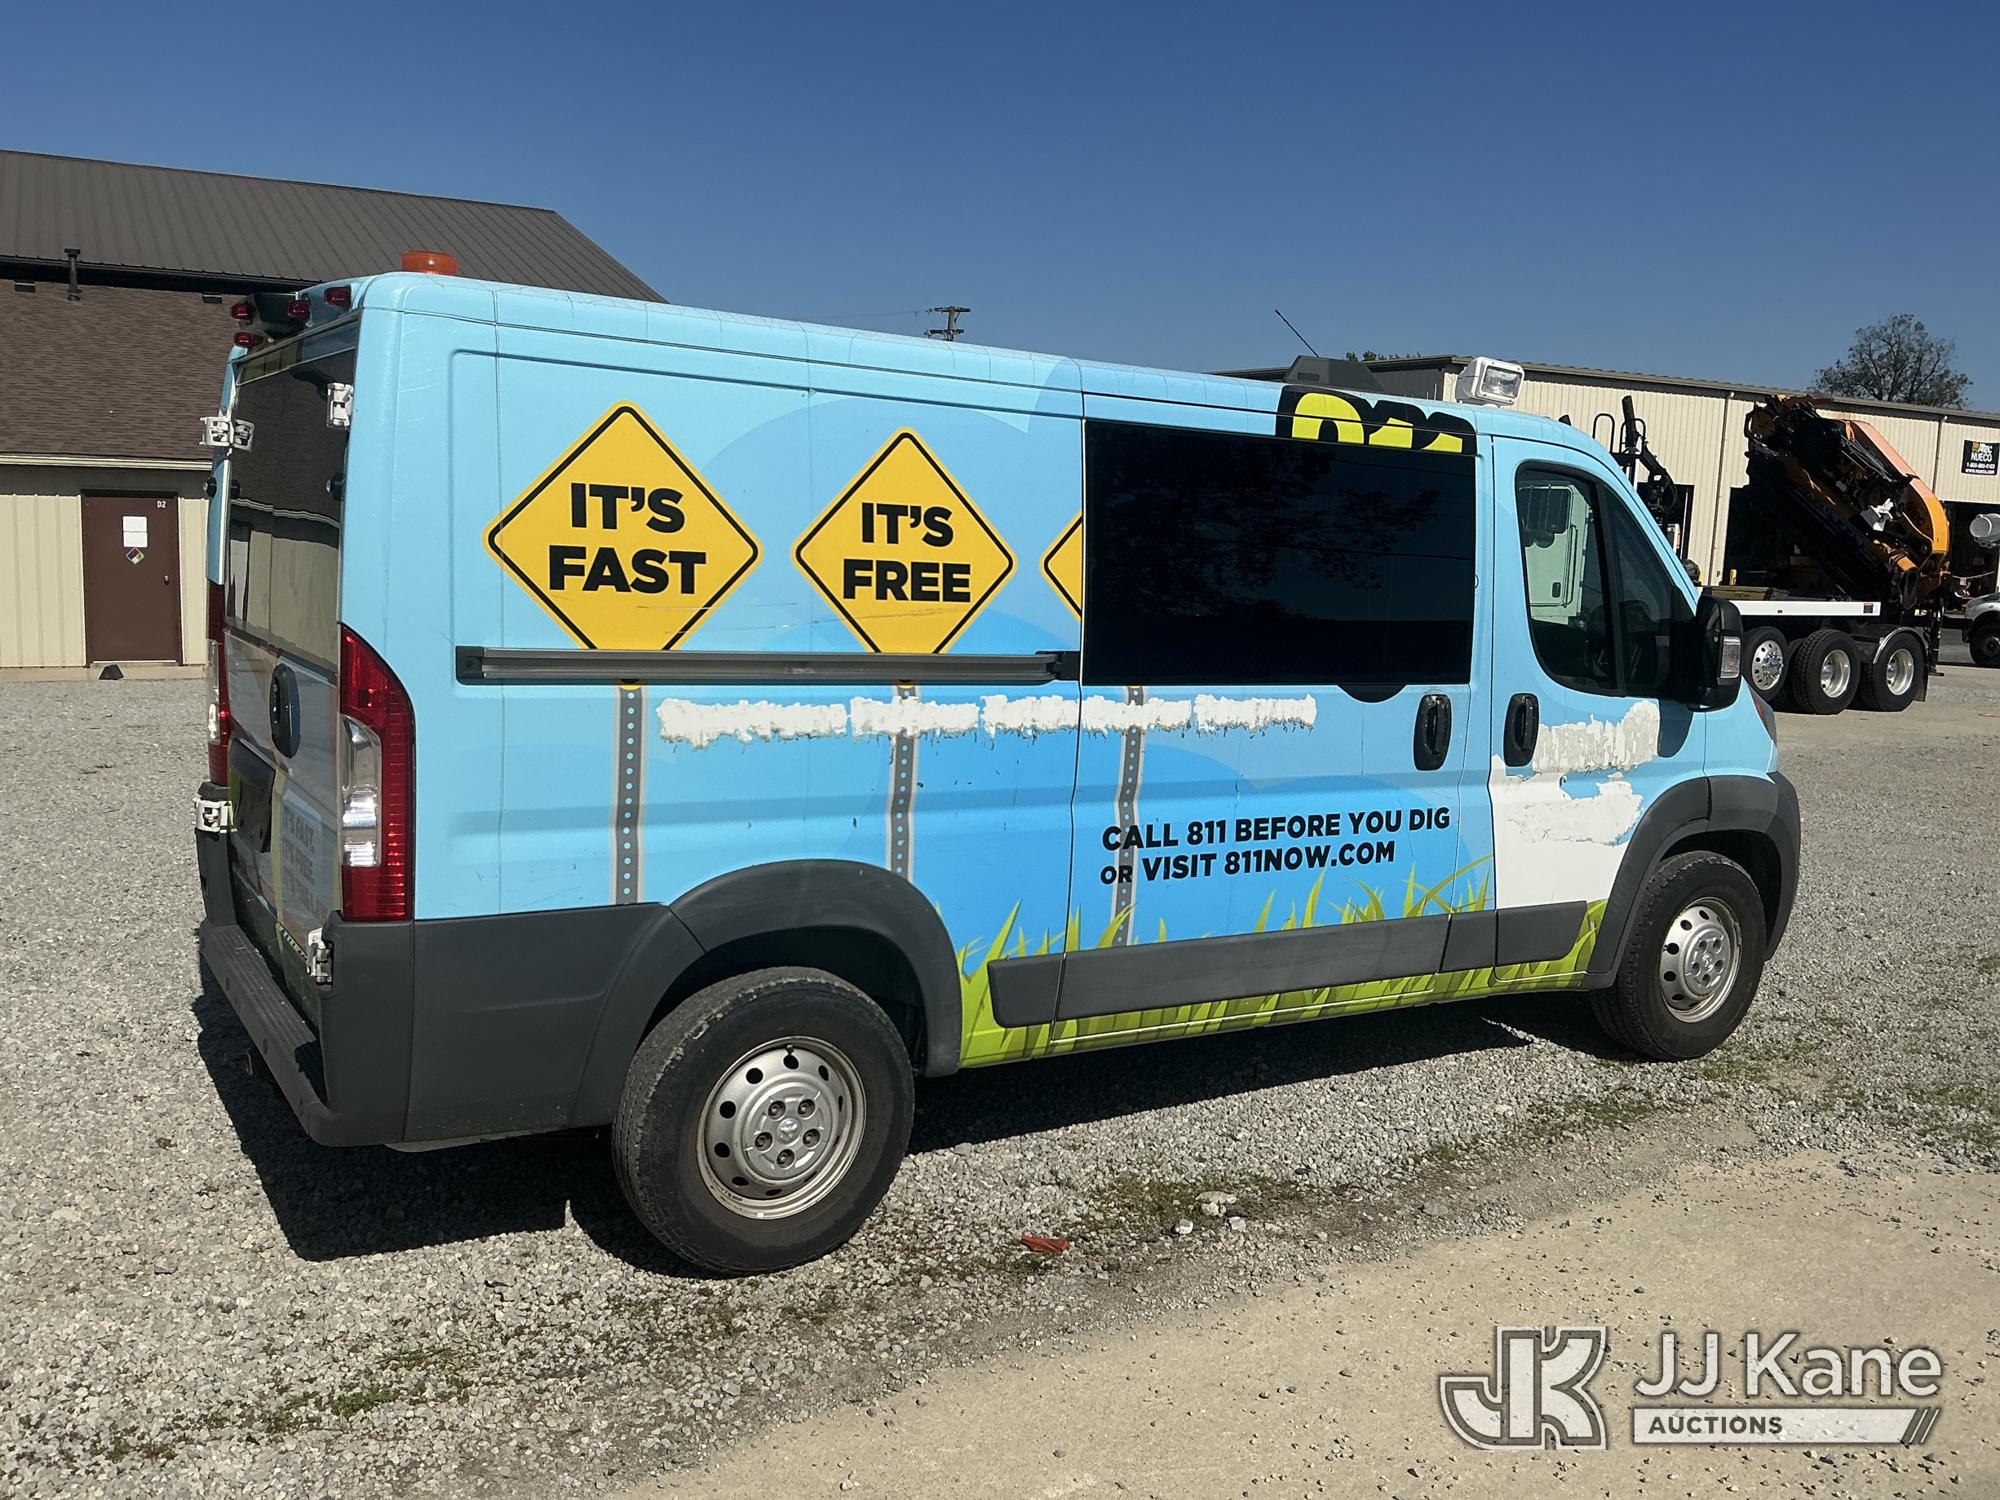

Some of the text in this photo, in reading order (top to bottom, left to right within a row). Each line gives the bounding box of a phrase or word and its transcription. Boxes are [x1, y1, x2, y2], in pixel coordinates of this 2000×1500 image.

[156, 500, 167, 508] D2
[570, 482, 685, 533] IT'S
[861, 502, 954, 547] IT'S
[548, 545, 706, 594] FAST
[843, 558, 971, 603] FREE
[1102, 807, 1450, 850] CALL 811 BEFORE YOU DIG
[1100, 841, 1395, 885] OR VISIT 811NOW.COM
